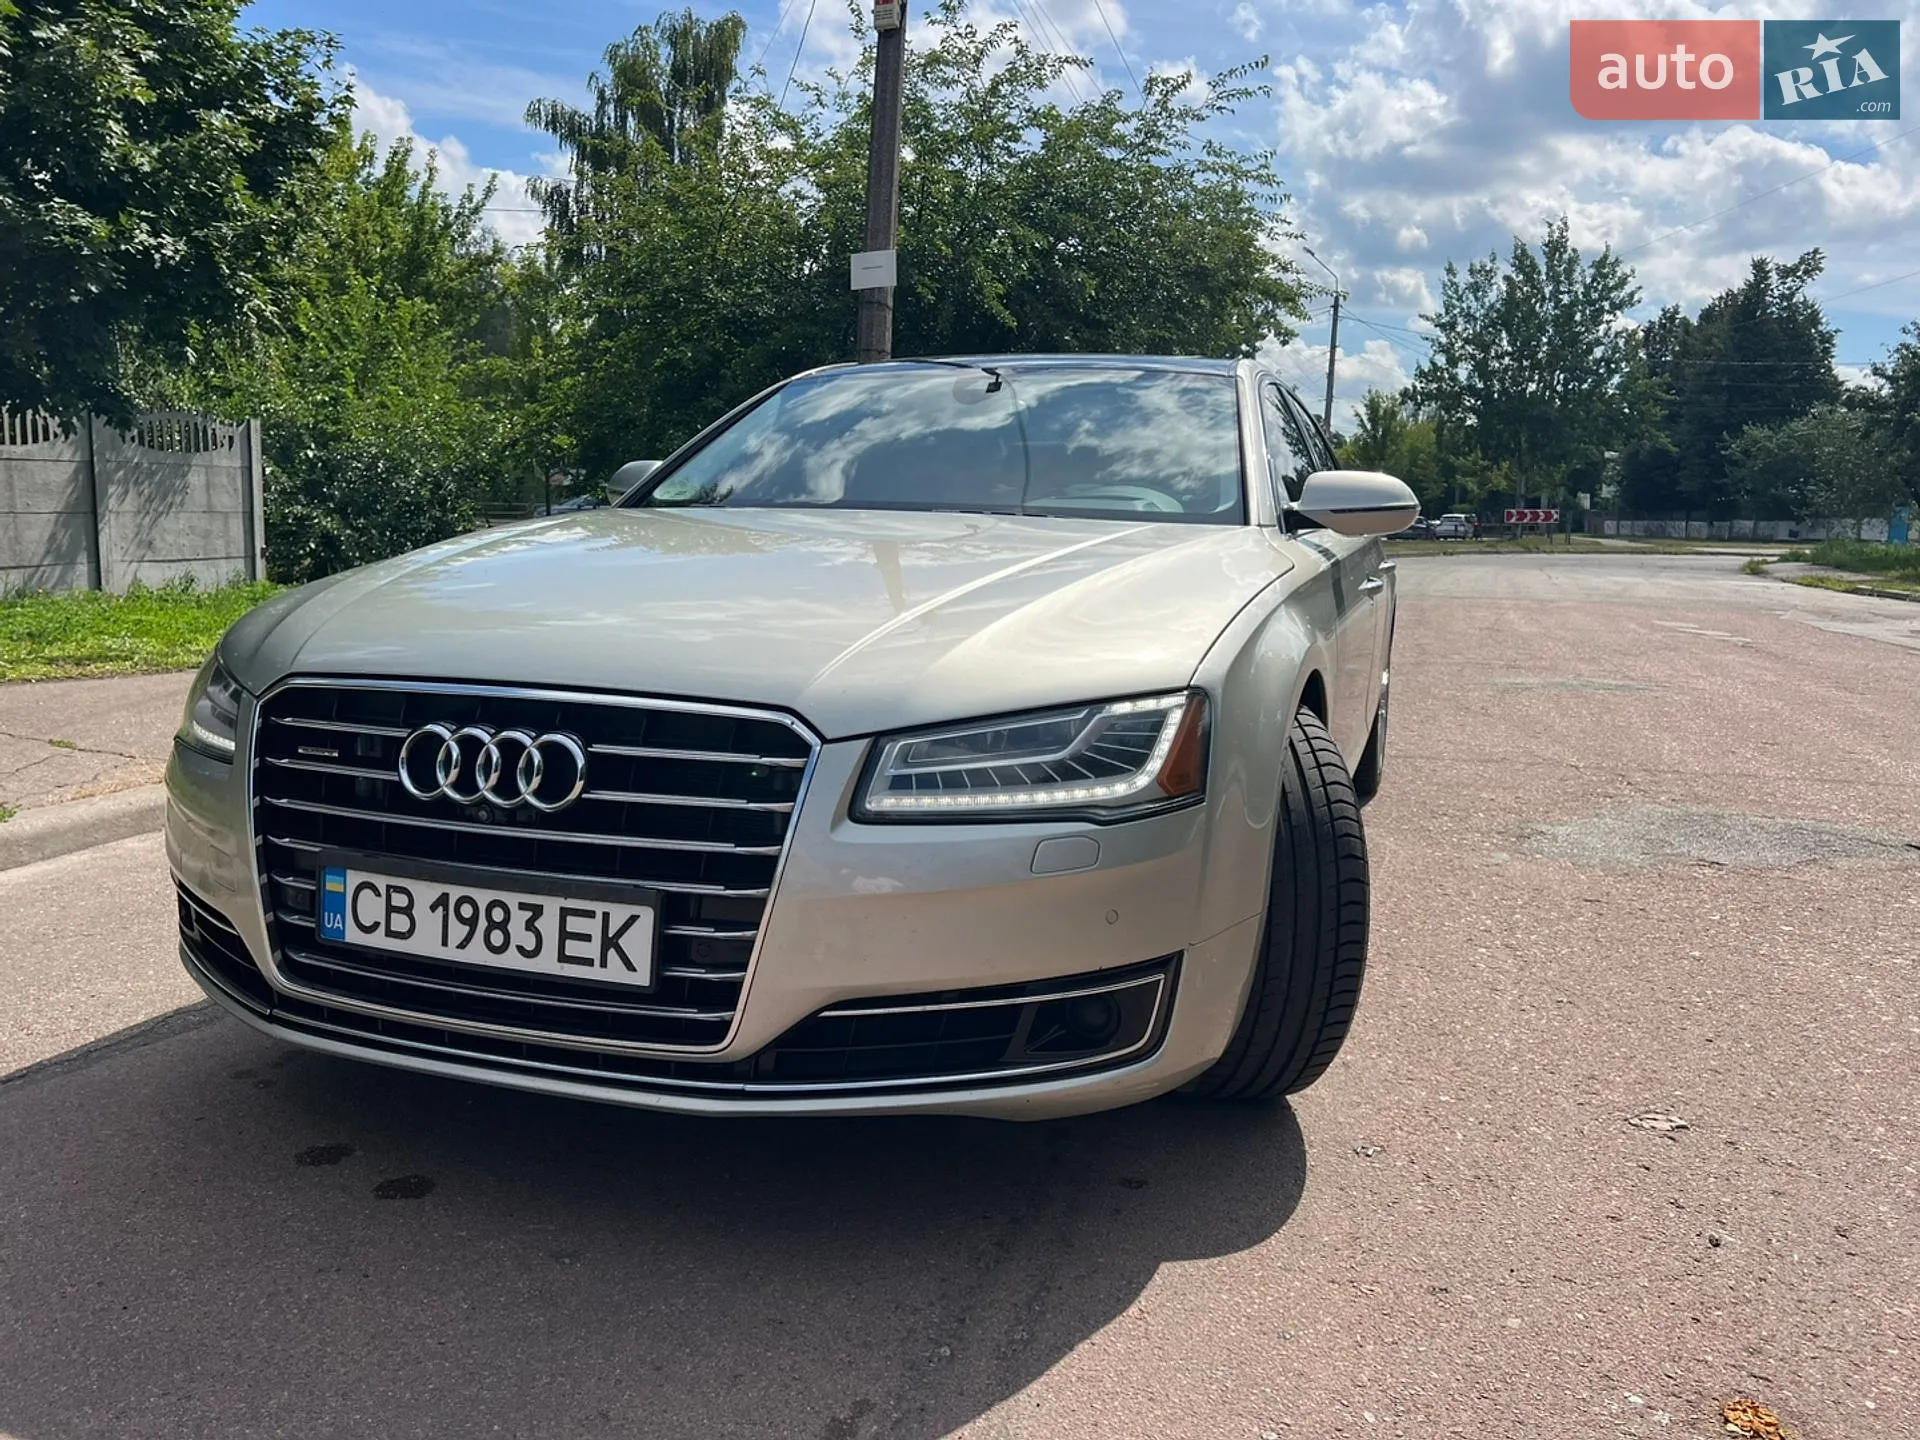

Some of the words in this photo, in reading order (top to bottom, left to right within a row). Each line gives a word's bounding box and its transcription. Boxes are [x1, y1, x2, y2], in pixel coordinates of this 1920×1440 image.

[324, 913, 343, 930] UA
[351, 881, 417, 940] CB
[429, 892, 544, 959] 1983
[557, 906, 641, 972] EK
